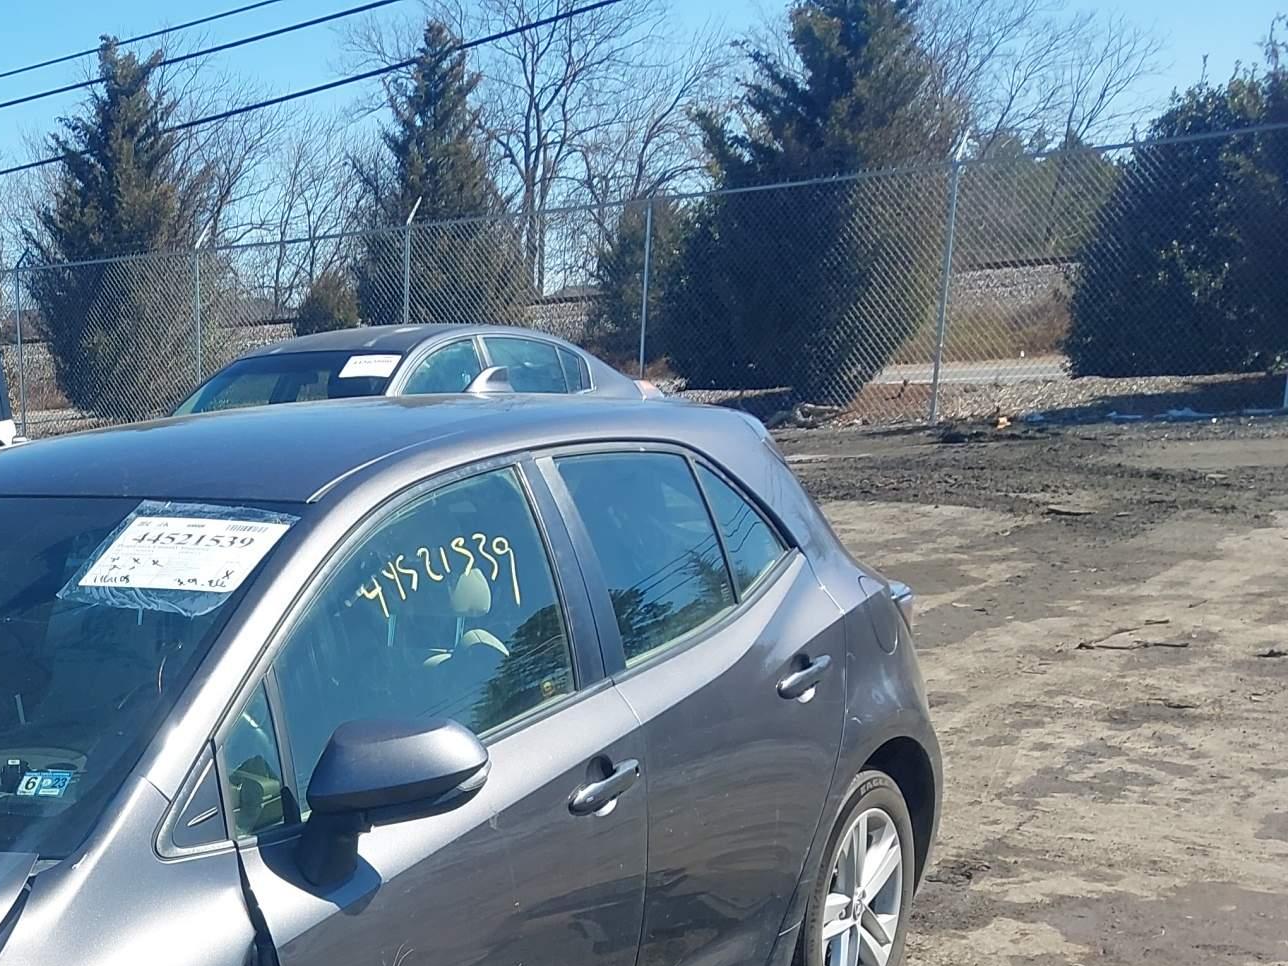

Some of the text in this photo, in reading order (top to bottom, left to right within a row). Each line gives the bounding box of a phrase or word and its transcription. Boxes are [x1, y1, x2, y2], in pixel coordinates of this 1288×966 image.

[132, 531, 255, 550] 44521539
[357, 532, 521, 618] 44521539
[24, 776, 68, 791] 6 23
